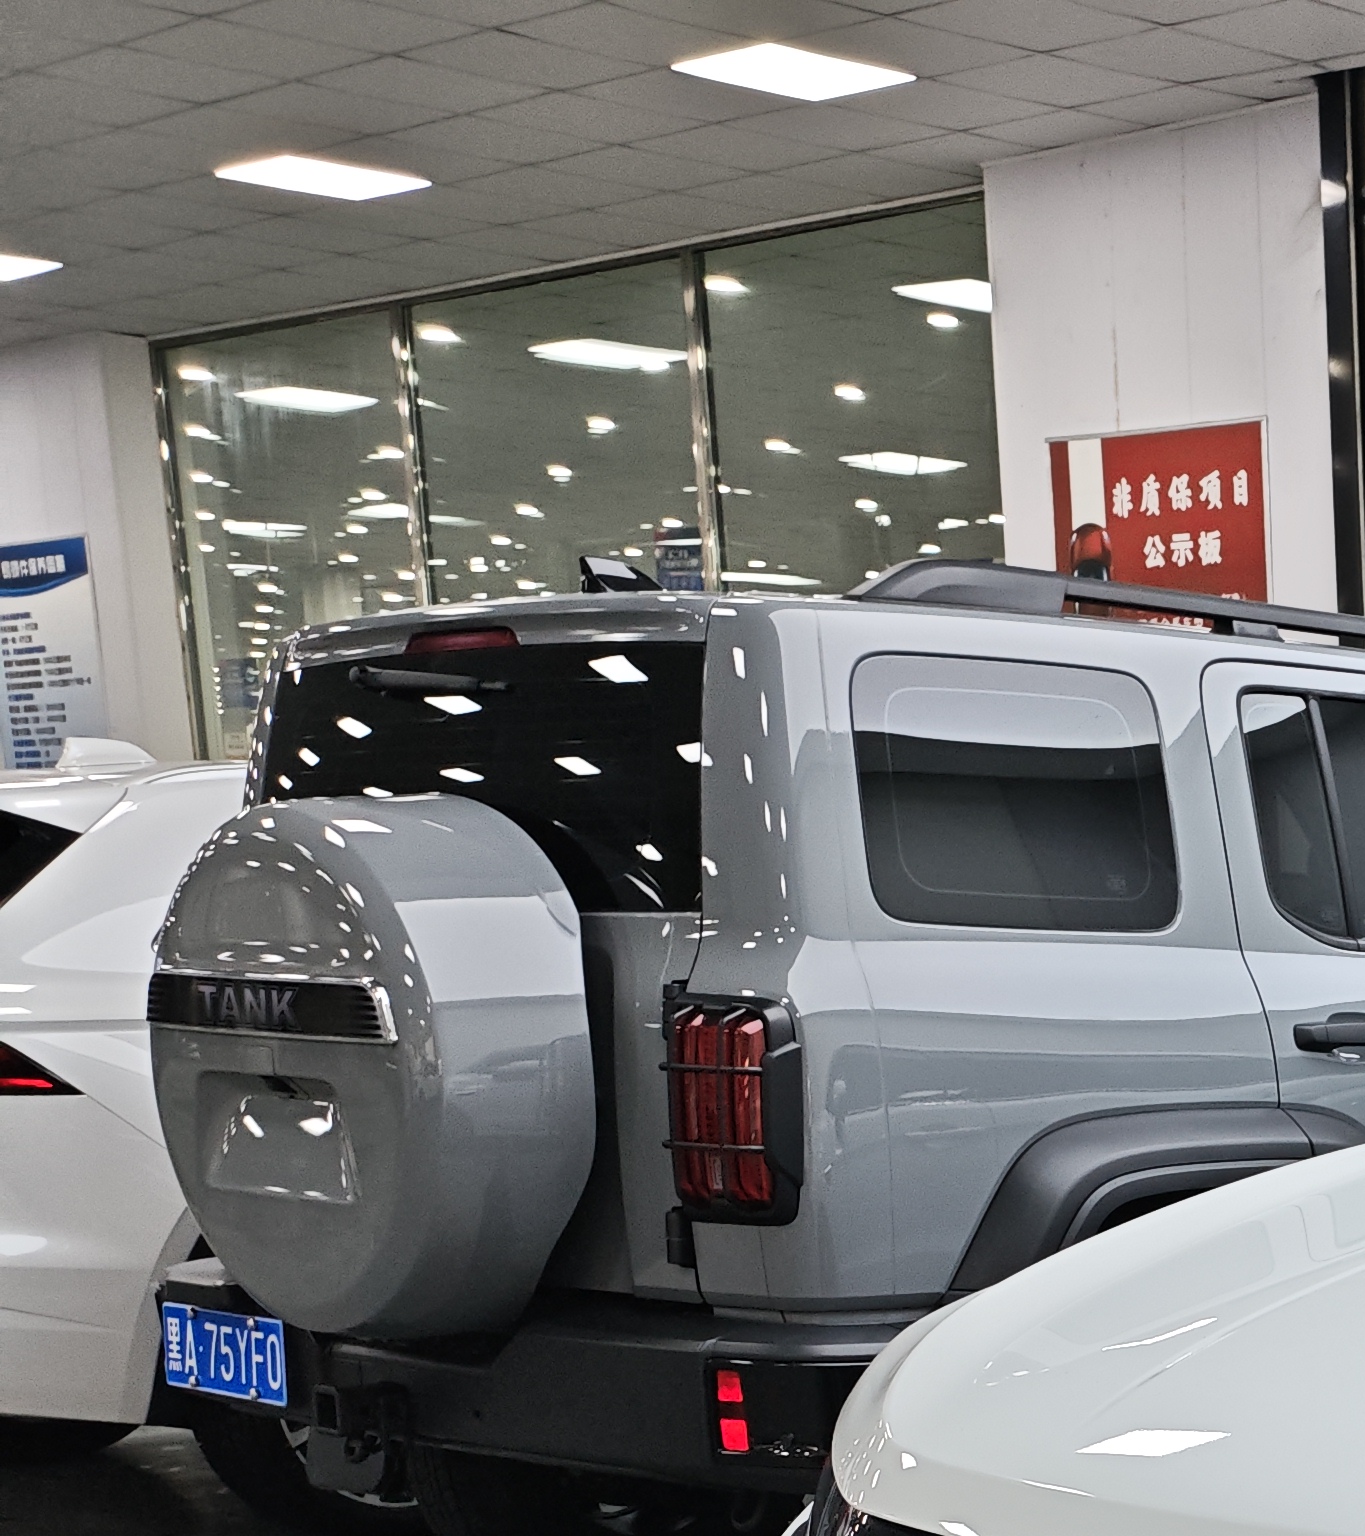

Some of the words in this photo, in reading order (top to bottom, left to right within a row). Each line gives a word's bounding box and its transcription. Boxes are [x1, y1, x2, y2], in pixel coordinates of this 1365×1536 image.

[1112, 469, 1249, 519] 非质保项目
[1143, 529, 1222, 569] 公示板
[197, 983, 298, 1027] TANK
